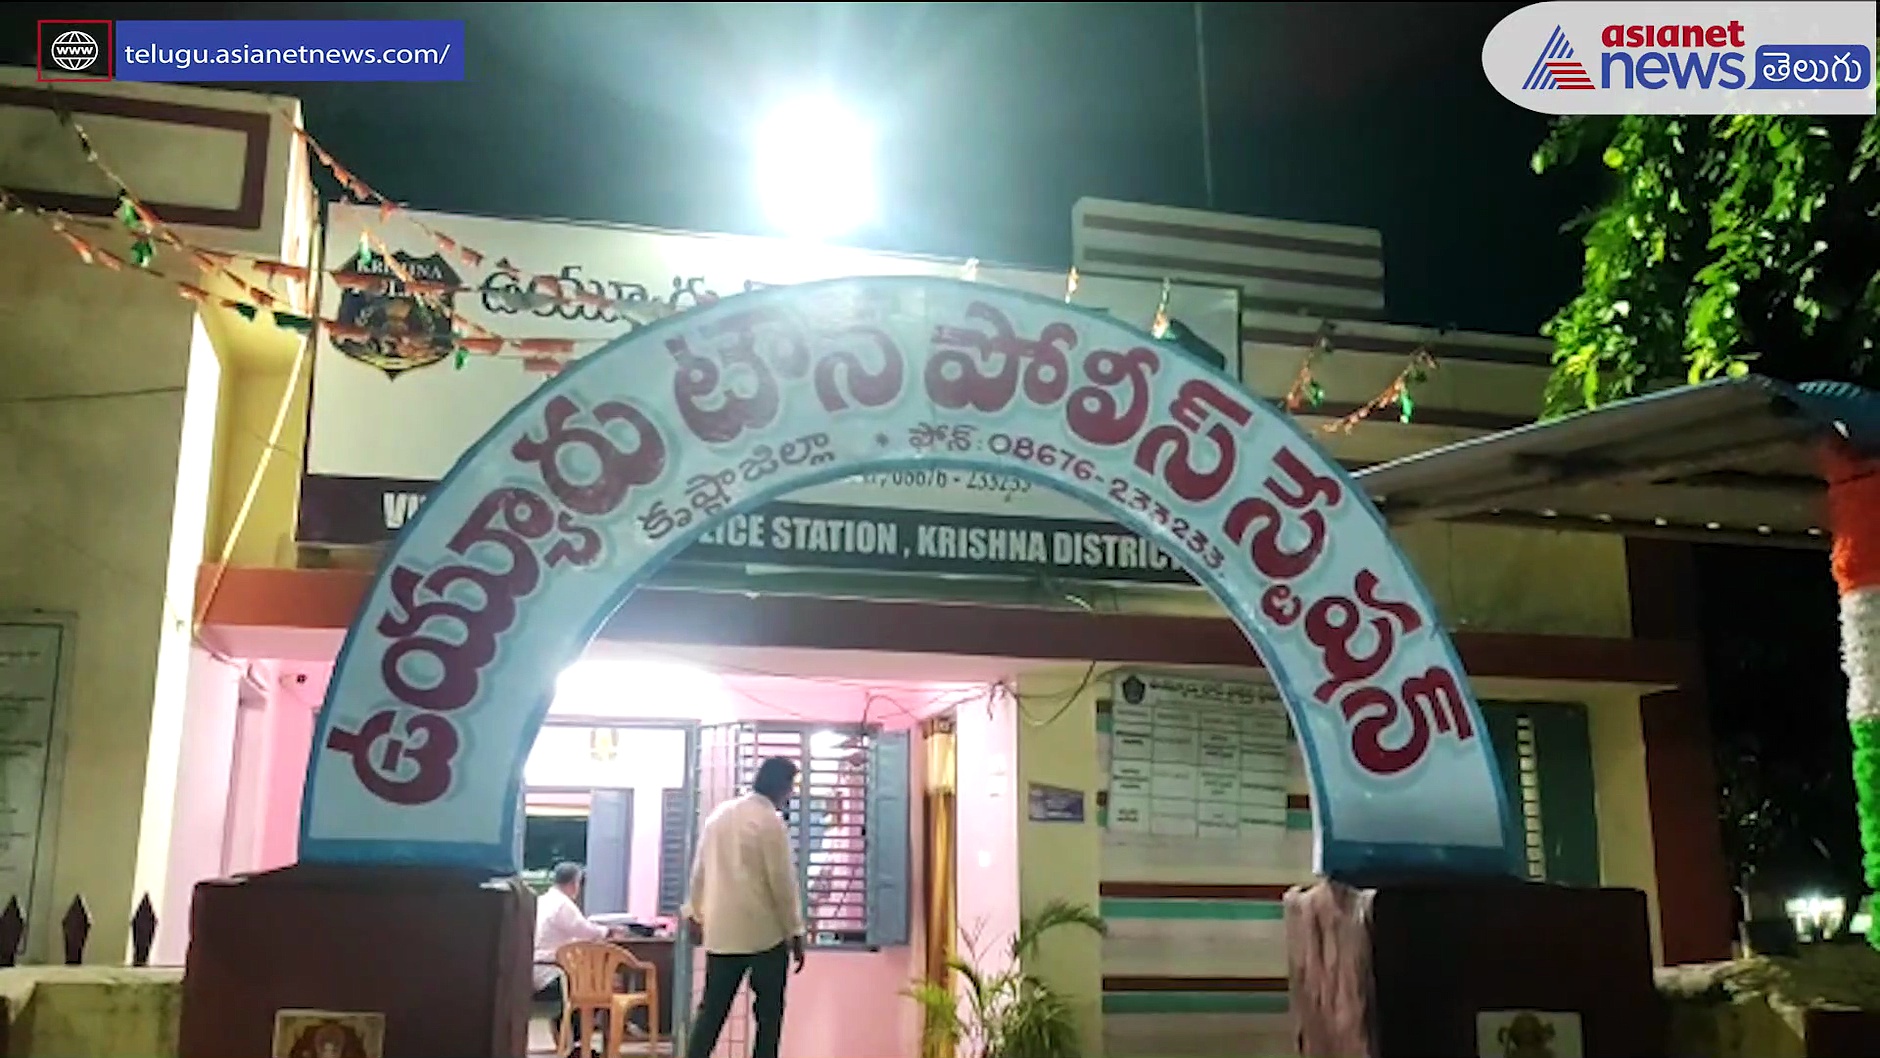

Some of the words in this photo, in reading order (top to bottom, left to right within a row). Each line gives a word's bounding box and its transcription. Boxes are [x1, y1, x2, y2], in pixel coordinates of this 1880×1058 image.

[327, 395, 666, 805] ఉయ్యూరు
[924, 301, 1254, 502] పోలీస్
[1223, 445, 1475, 775] స్టేషన్
[771, 515, 898, 555] STATION
[917, 524, 1048, 564] KRISHNA
[1053, 530, 1182, 571] DISTRIC
